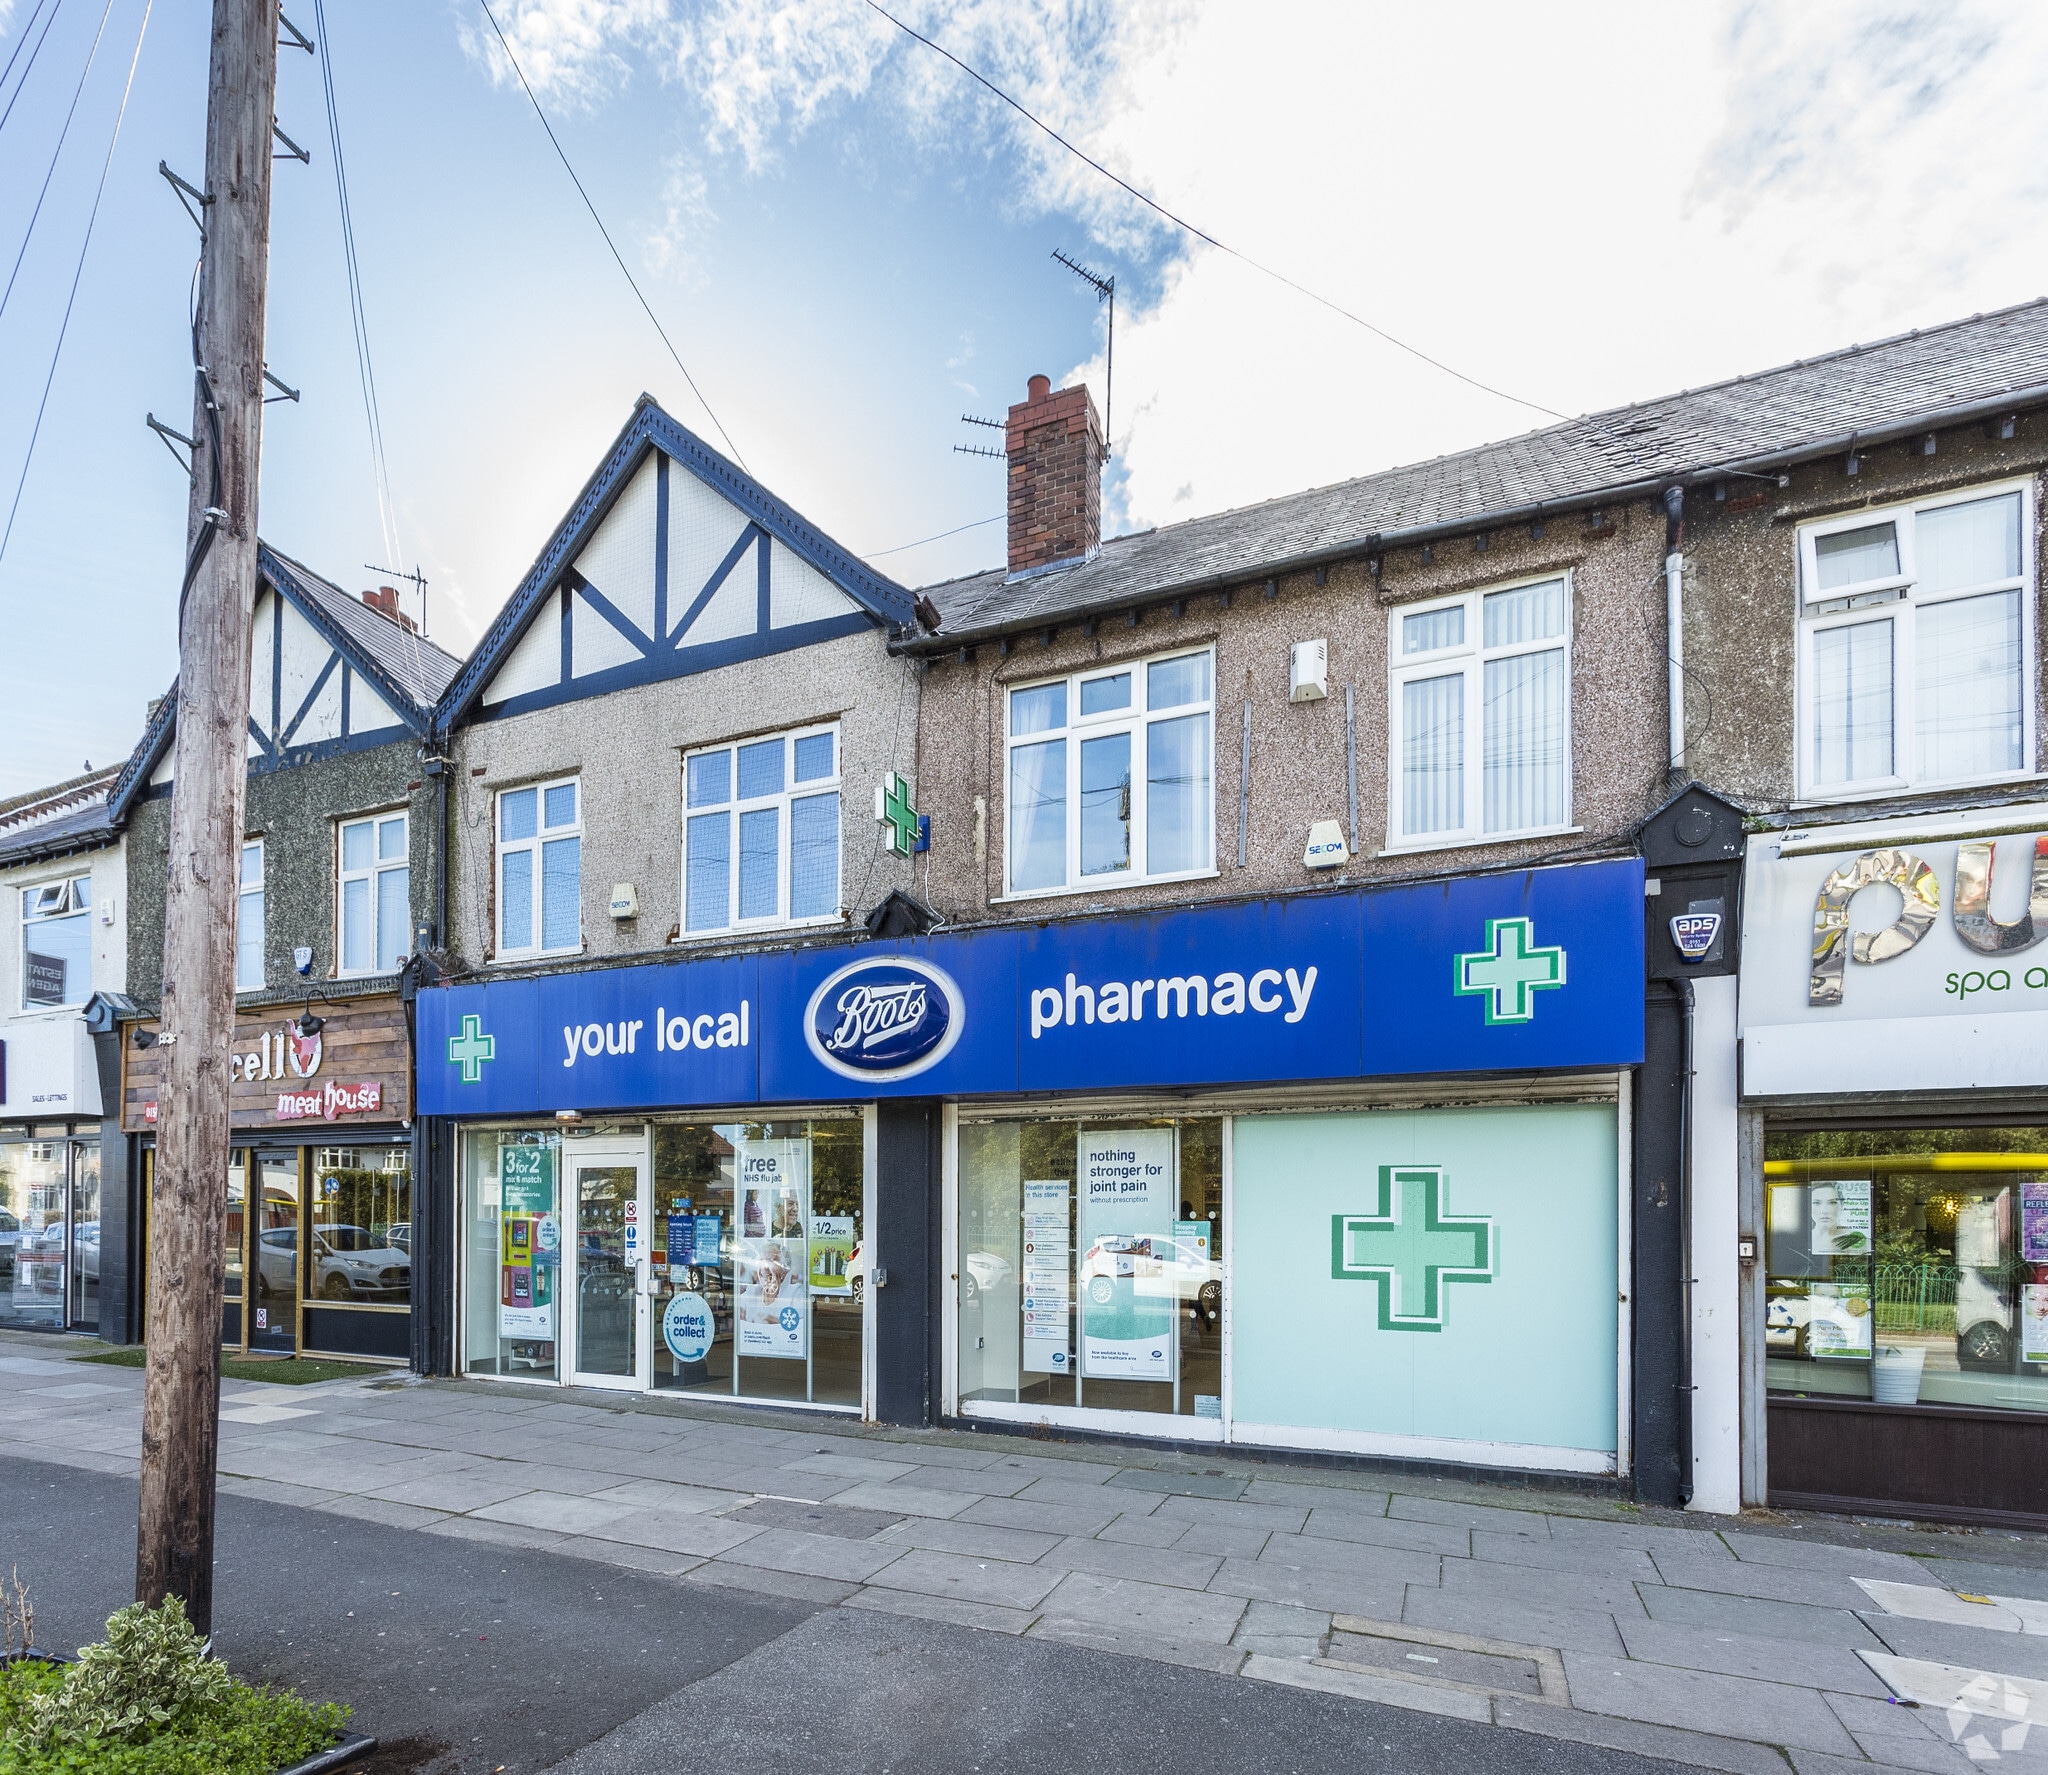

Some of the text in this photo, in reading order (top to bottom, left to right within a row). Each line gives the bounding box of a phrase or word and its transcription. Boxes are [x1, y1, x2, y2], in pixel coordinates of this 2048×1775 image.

[1309, 843, 1342, 854] SECOM
[611, 900, 630, 908] SECOM
[1679, 918, 1713, 934] aps
[1945, 969, 2012, 1000] spa
[1031, 966, 1318, 1039] pharmacy
[826, 982, 928, 1050] Boots
[563, 1000, 749, 1067] your local
[277, 1081, 380, 1115] meat house
[505, 1151, 516, 1173] 3
[529, 1151, 541, 1173] 2
[744, 1154, 777, 1172] free
[1090, 1149, 1136, 1163] nothing
[744, 1173, 782, 1183] NHS flu jab
[1090, 1164, 1163, 1178] stronger for
[521, 1175, 542, 1183] match
[1090, 1180, 1147, 1194] joint pain
[1113, 1196, 1148, 1204] prescription
[815, 1222, 832, 1234] 1/2
[1842, 1286, 1867, 1297] pure
[673, 1326, 706, 1338] collect
